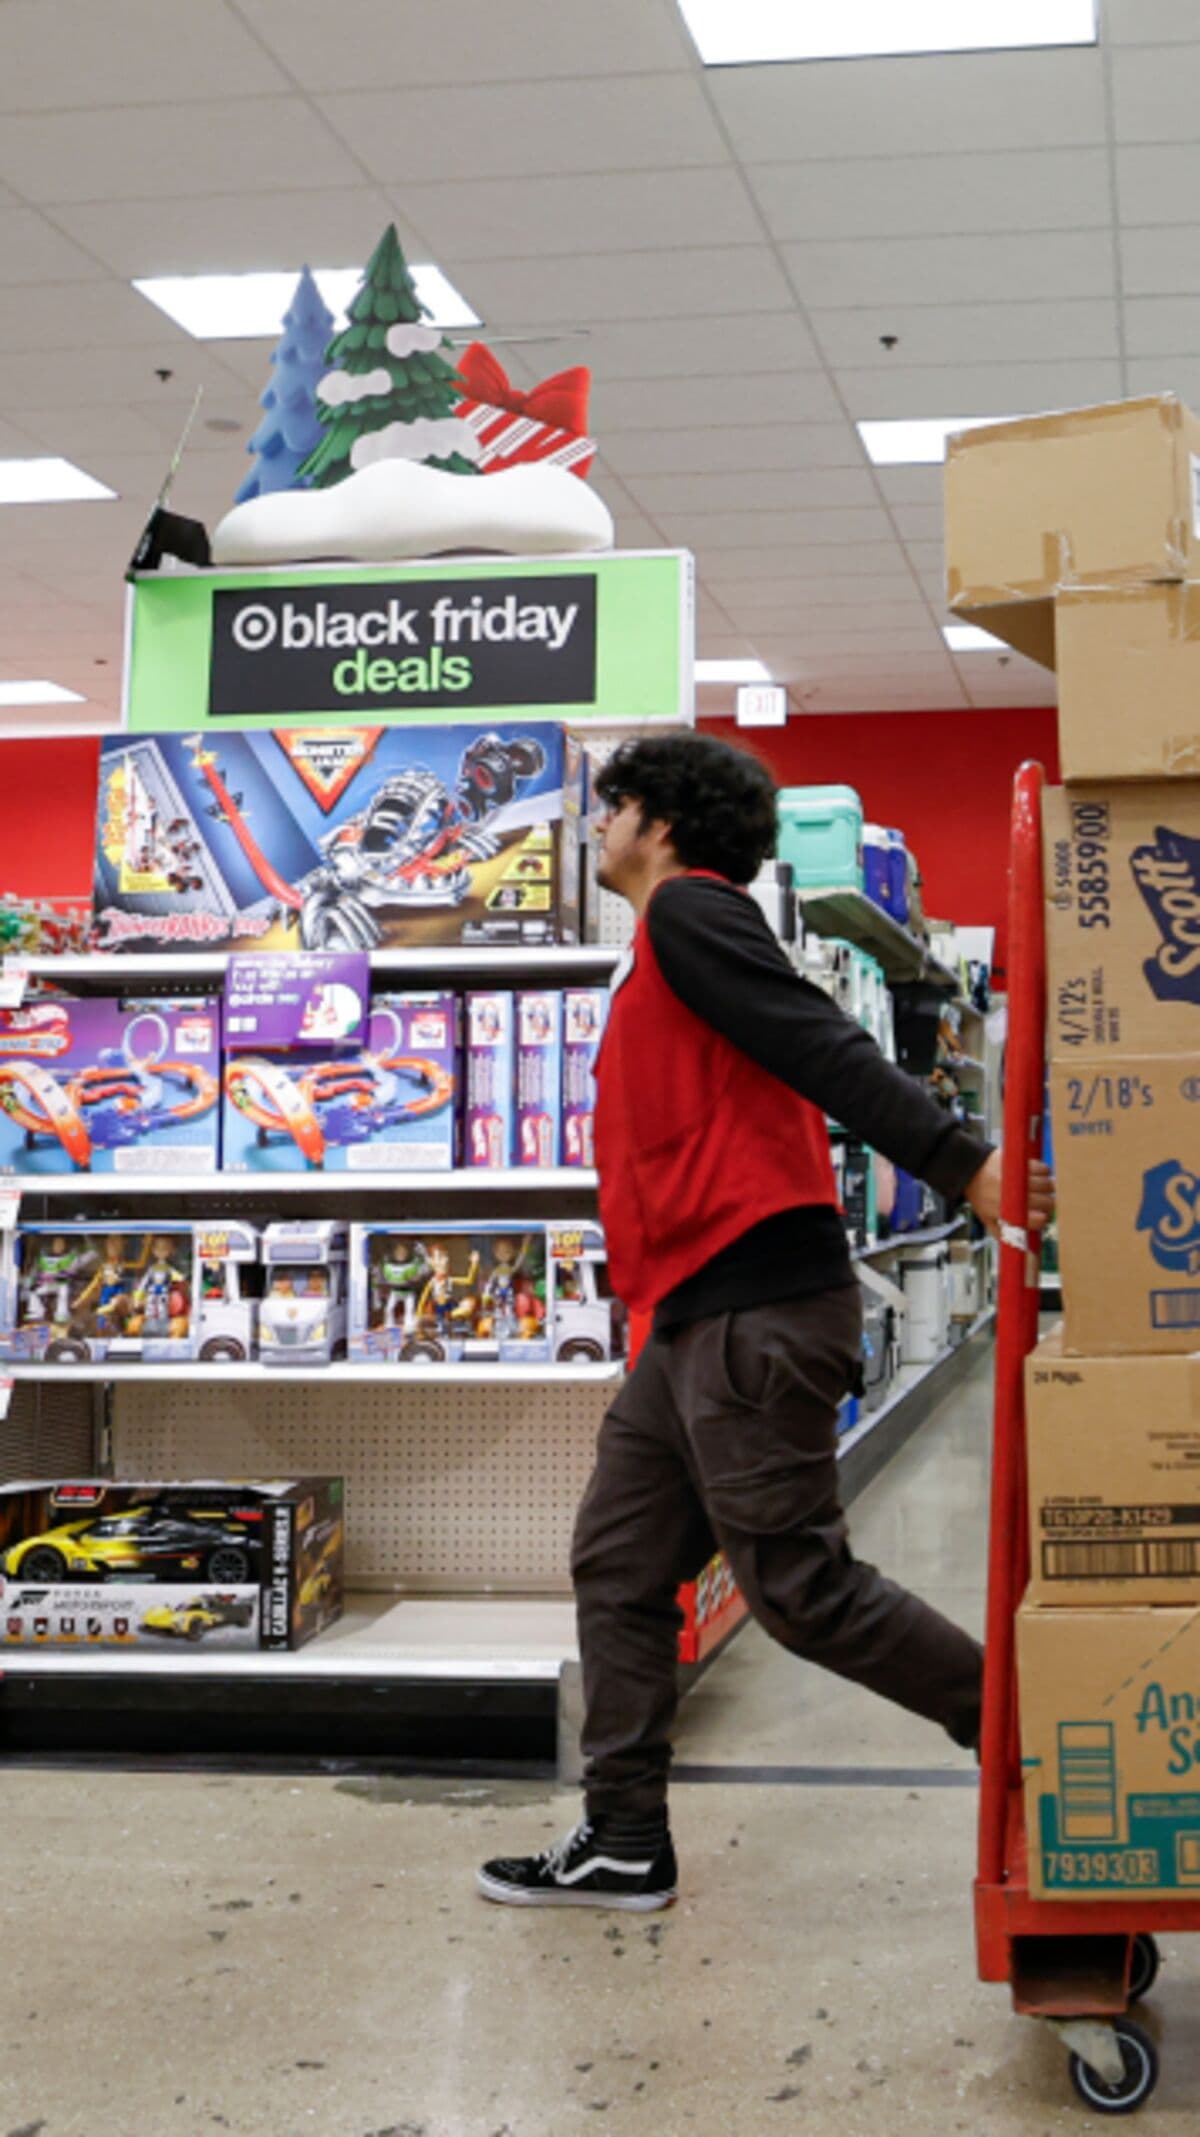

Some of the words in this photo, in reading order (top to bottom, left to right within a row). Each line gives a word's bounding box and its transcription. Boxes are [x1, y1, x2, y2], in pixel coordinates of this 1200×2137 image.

[281, 599, 419, 649] black
[430, 595, 580, 650] friday
[332, 646, 473, 695] deals
[743, 690, 778, 716] EXIT
[1074, 803, 1110, 929] 5585900
[1057, 976, 1090, 1047] 4/12's
[1066, 1075, 1154, 1118] 2/18's
[1158, 1174, 1200, 1239] S
[1032, 1370, 1049, 1385] 24
[1133, 1681, 1200, 1733] An
[1046, 1850, 1157, 1883] 7939303
